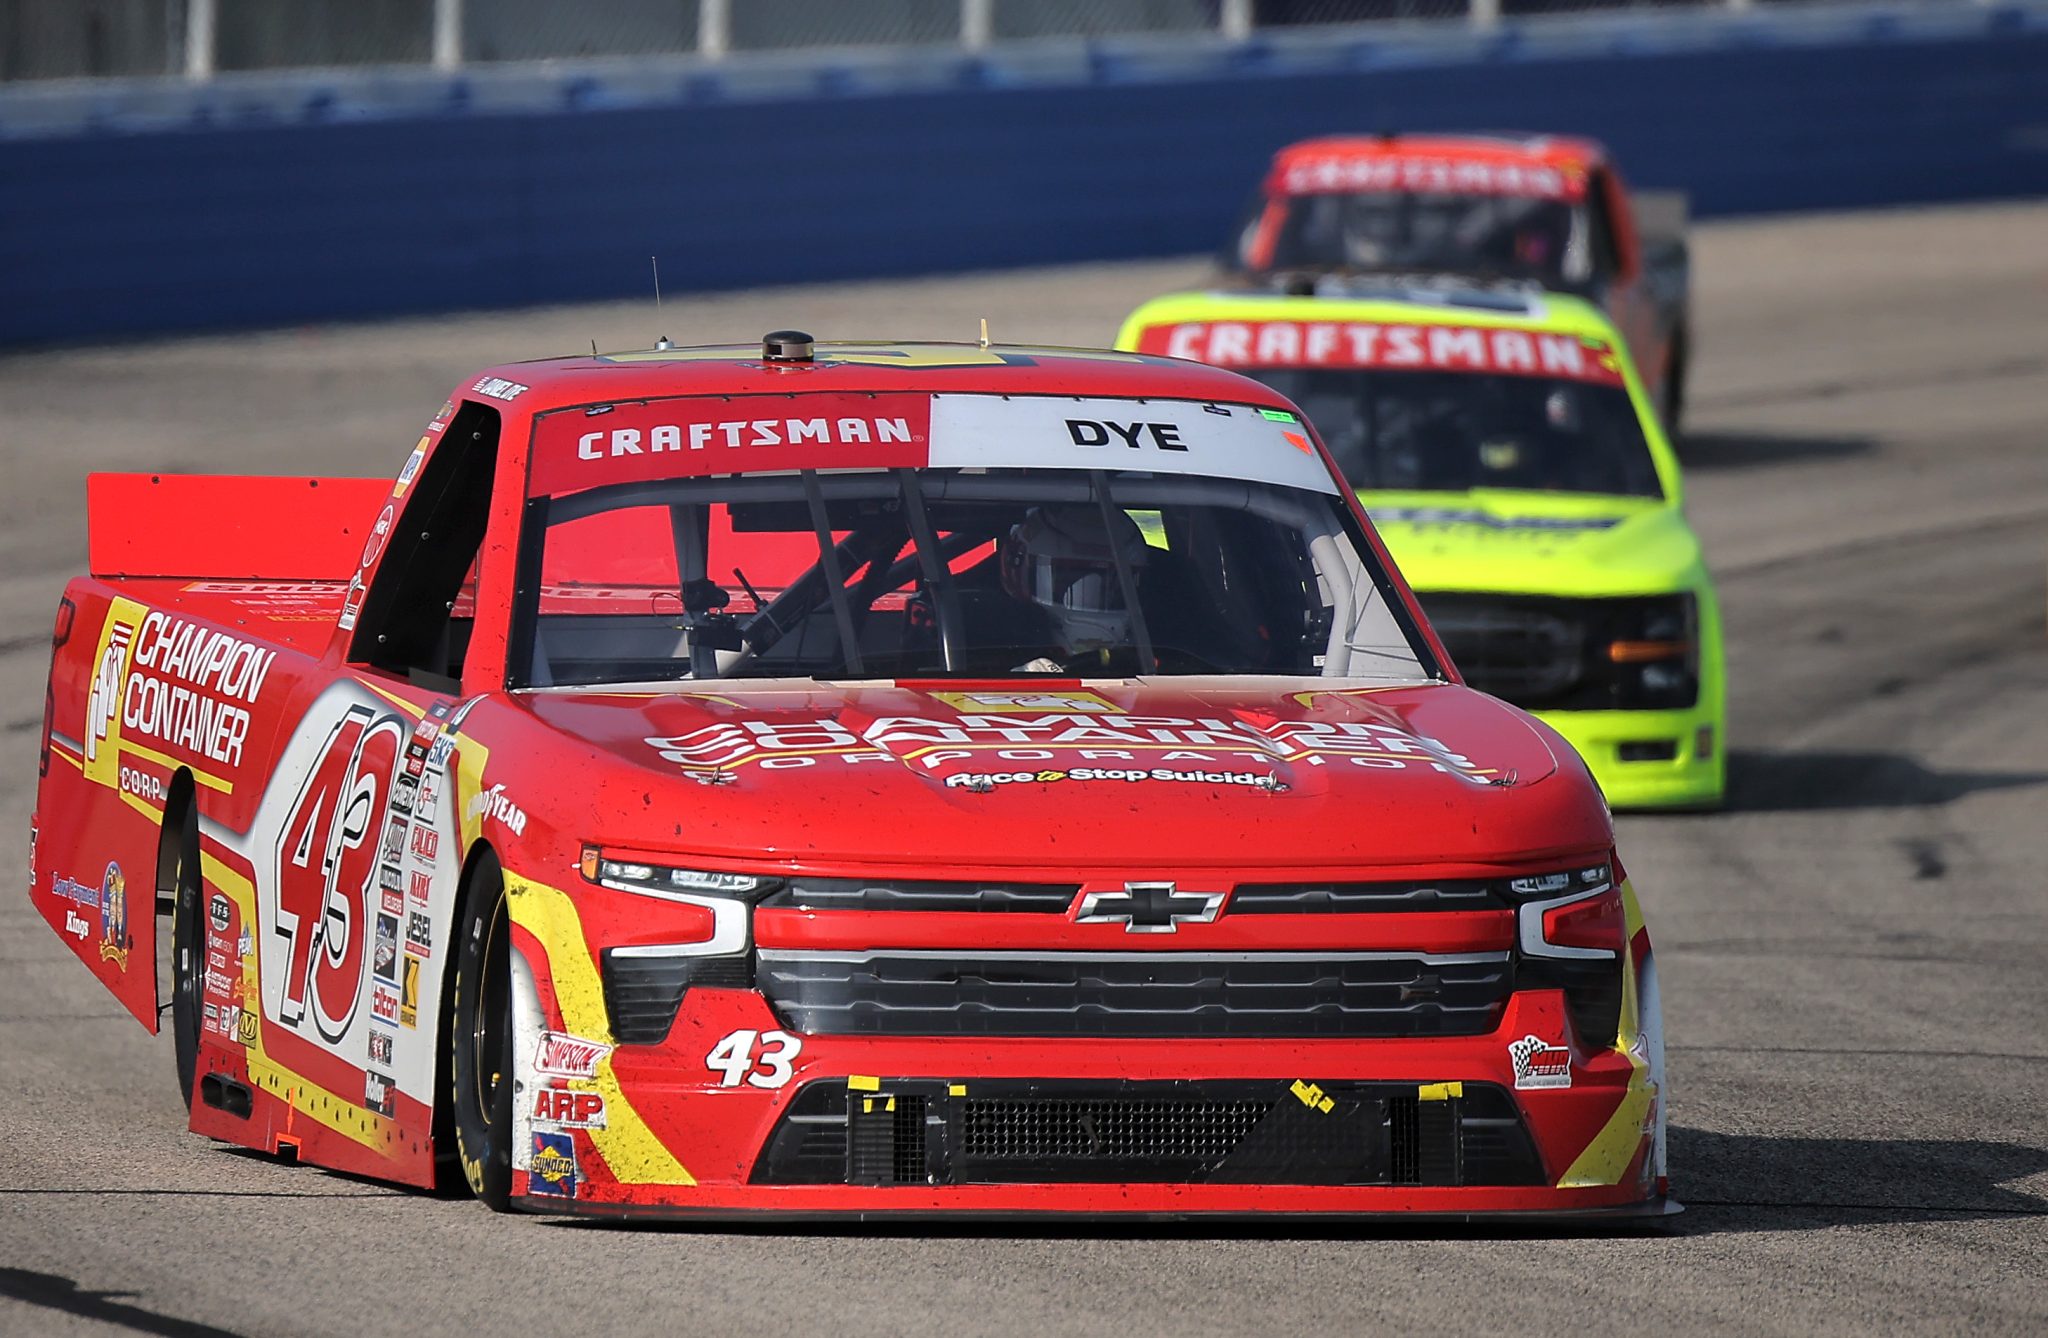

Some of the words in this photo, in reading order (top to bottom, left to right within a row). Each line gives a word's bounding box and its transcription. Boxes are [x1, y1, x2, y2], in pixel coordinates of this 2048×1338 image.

[1168, 322, 1587, 375] CRAFTSMAN
[577, 418, 913, 461] CRAFTSMAN
[1065, 418, 1189, 452] DYE
[134, 611, 277, 704] CHAMPION
[123, 671, 251, 768] CONTAINER
[658, 726, 1477, 769] CONTAINER
[944, 771, 1034, 788] Race
[1036, 770, 1067, 782] to
[1068, 767, 1149, 782] Stop
[1151, 768, 1278, 786] Suicide
[466, 783, 528, 838] GOODYEAR
[274, 702, 407, 1045] 43
[65, 909, 90, 941] Kings
[405, 910, 432, 949] JESEL
[541, 1039, 605, 1073] SIMPSON
[705, 1029, 802, 1089] 43
[533, 1089, 604, 1123] ARP
[532, 1155, 574, 1175] SUNOCO
